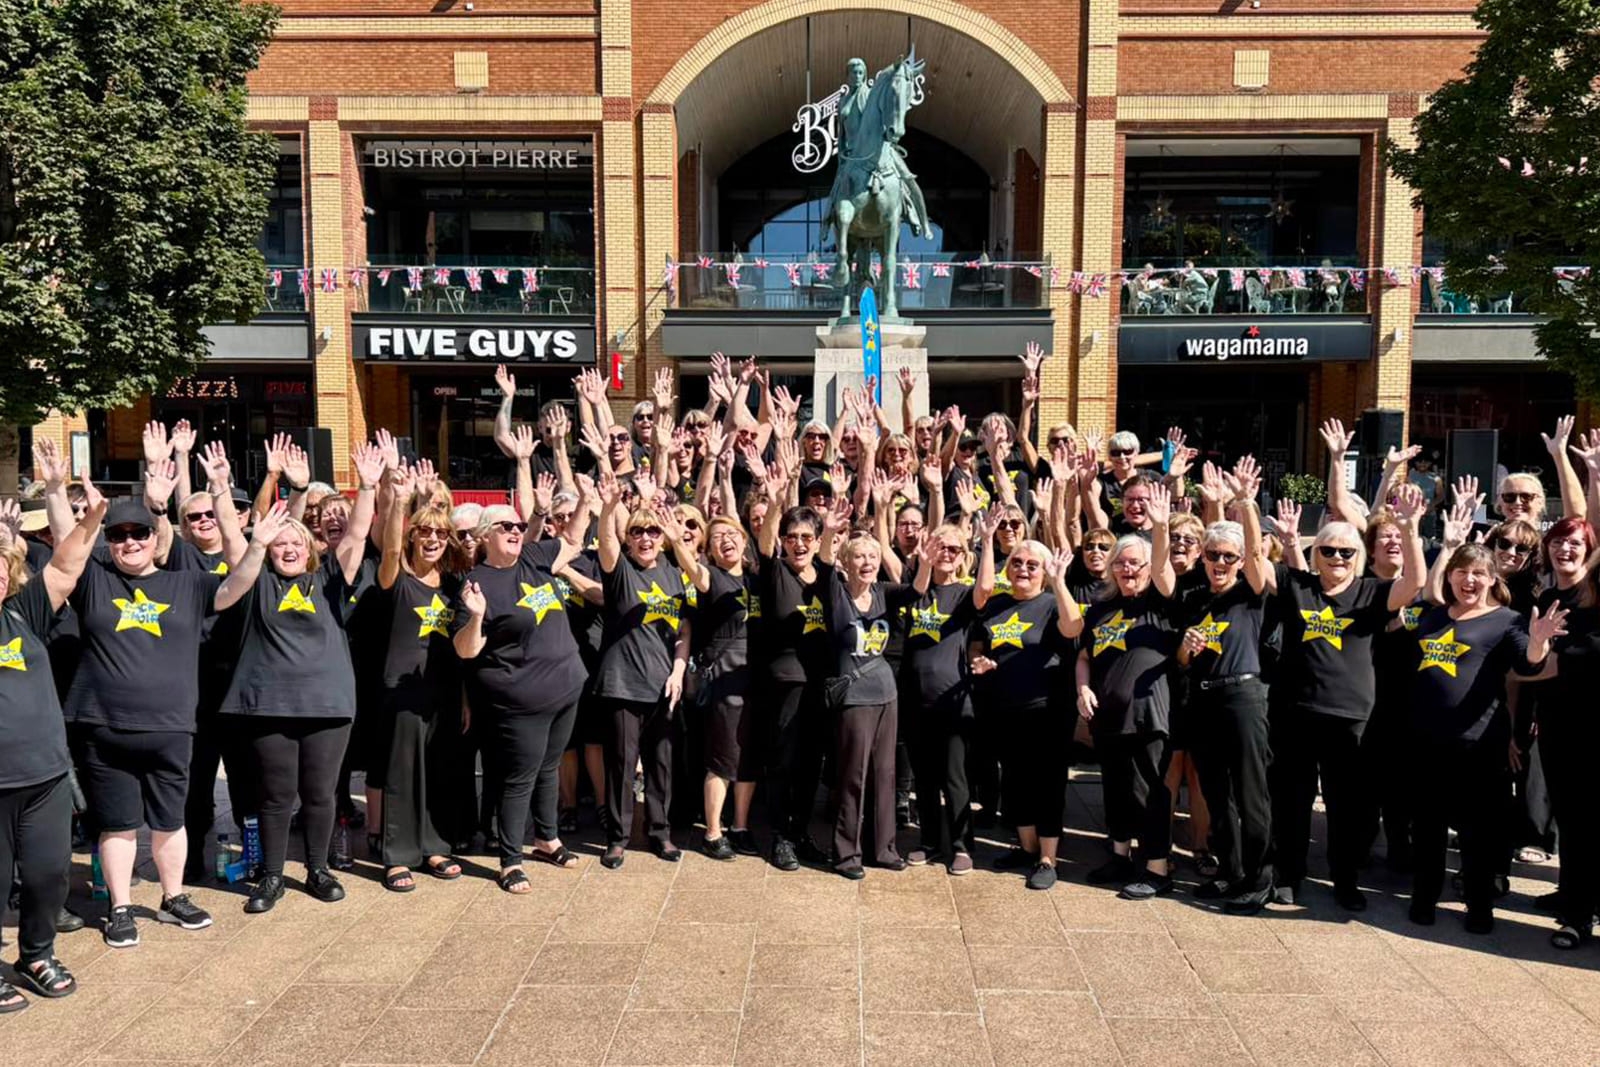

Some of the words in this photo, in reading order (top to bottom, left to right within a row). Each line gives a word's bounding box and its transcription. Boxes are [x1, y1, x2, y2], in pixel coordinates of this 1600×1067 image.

[374, 149, 480, 168] BISTROT
[492, 149, 579, 168] PIERRE
[369, 327, 458, 355] FIVE
[469, 329, 578, 358] GUYS
[1186, 338, 1309, 360] wagamama
[1304, 622, 1343, 639] CHOIR
[1426, 641, 1457, 654] ROCK
[1423, 652, 1459, 664] CHOIR
